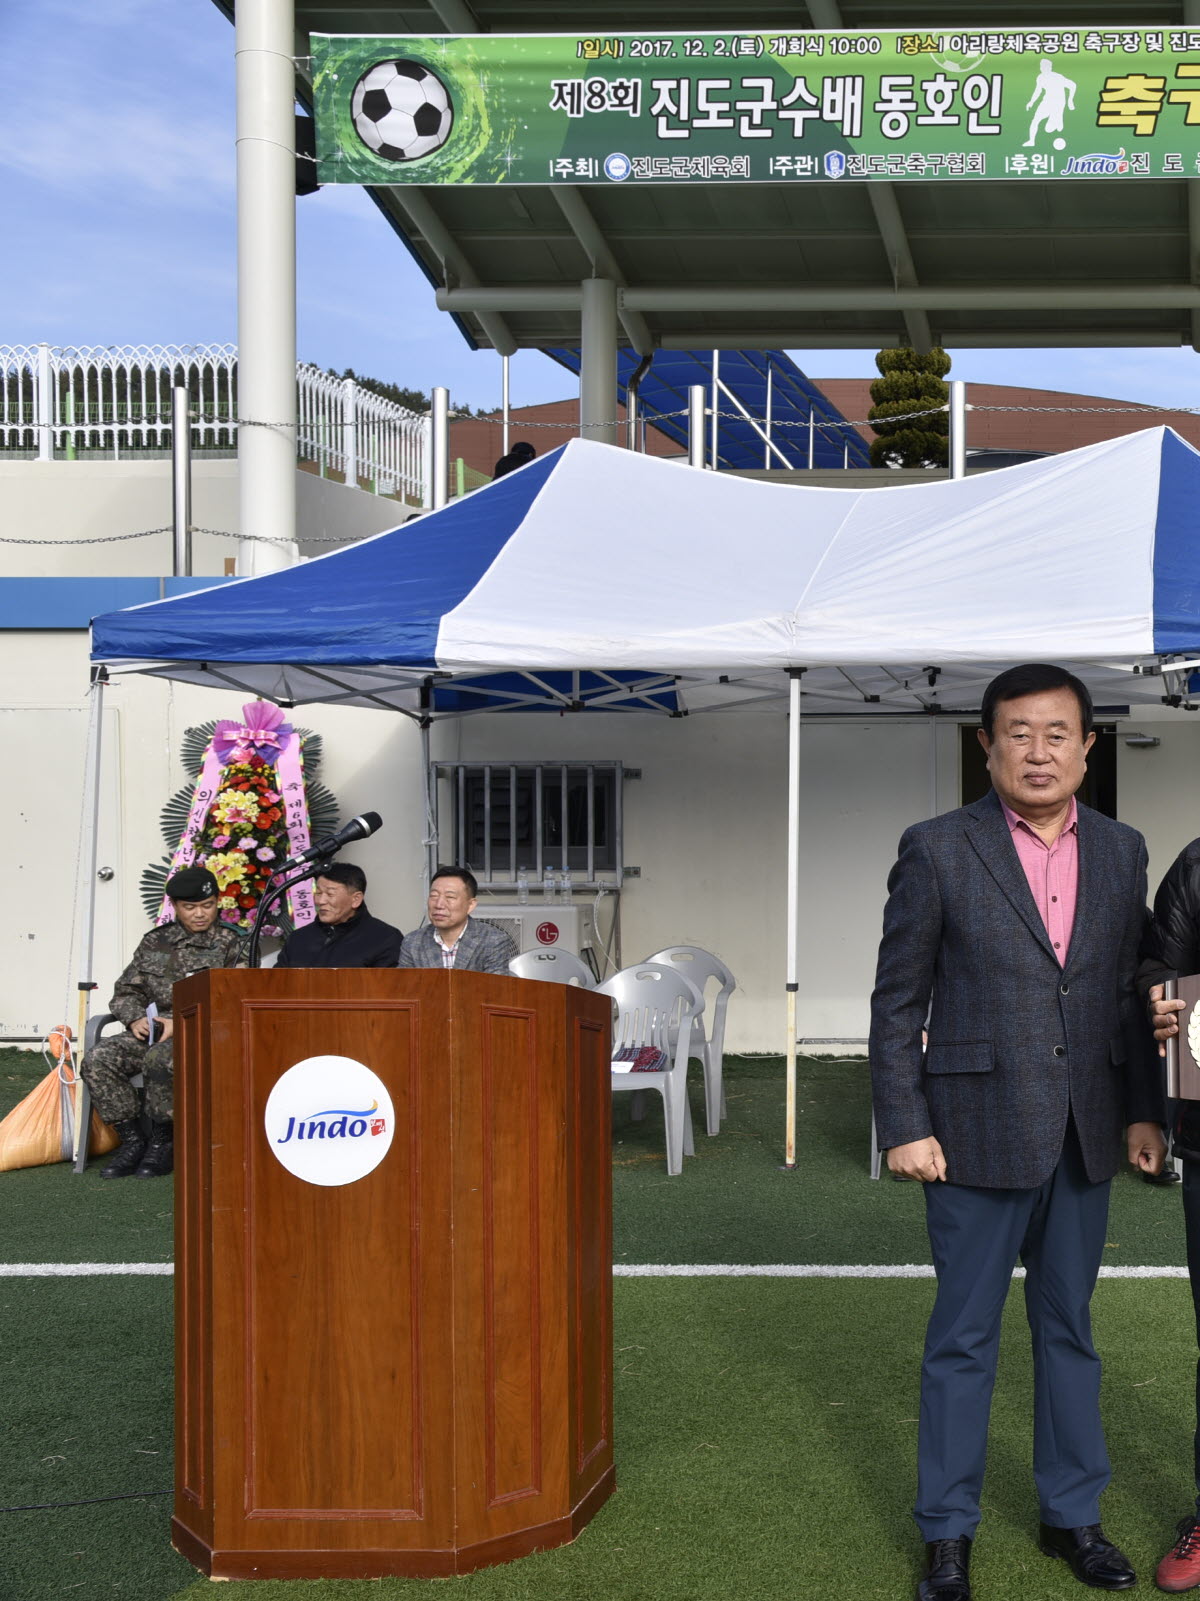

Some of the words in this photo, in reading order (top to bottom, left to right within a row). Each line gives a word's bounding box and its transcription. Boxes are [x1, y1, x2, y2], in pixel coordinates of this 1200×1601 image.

[630, 39, 677, 58] 2017.
[683, 39, 708, 57] 12.
[769, 36, 824, 56] 개회식
[830, 37, 881, 55] 10:00
[950, 33, 1079, 54] 아리랑체육공원
[1084, 33, 1139, 53] 축구장
[1145, 33, 1163, 52] 및
[549, 77, 641, 118] 제8회
[649, 75, 864, 139] 진도군수배
[874, 73, 1003, 140] 동호인
[632, 155, 750, 179] 진도군체육회
[846, 153, 985, 176] 진도군축구협회
[1061, 156, 1117, 175] Jindo
[536, 922, 559, 945] LG
[277, 1116, 367, 1143] Jindo
